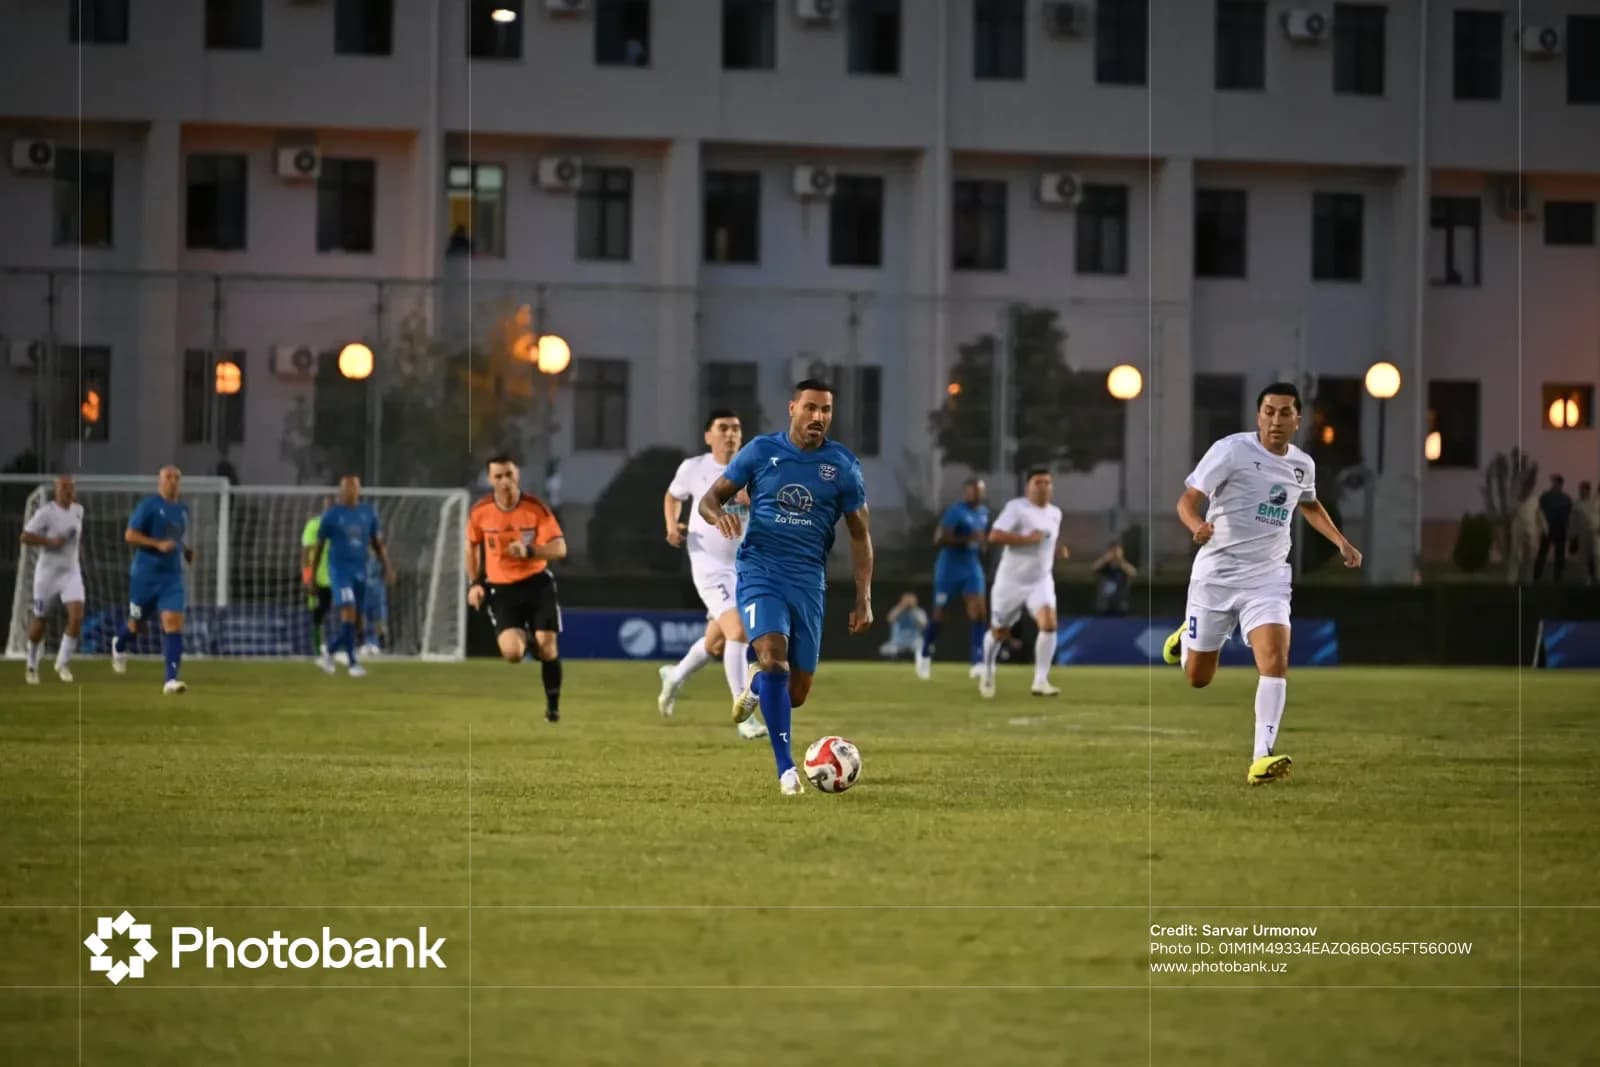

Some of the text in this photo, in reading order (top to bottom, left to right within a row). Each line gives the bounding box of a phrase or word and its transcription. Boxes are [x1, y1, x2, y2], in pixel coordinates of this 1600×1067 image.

[1257, 503, 1289, 521] BMB
[718, 583, 730, 601] 3
[1188, 616, 1197, 639] 9
